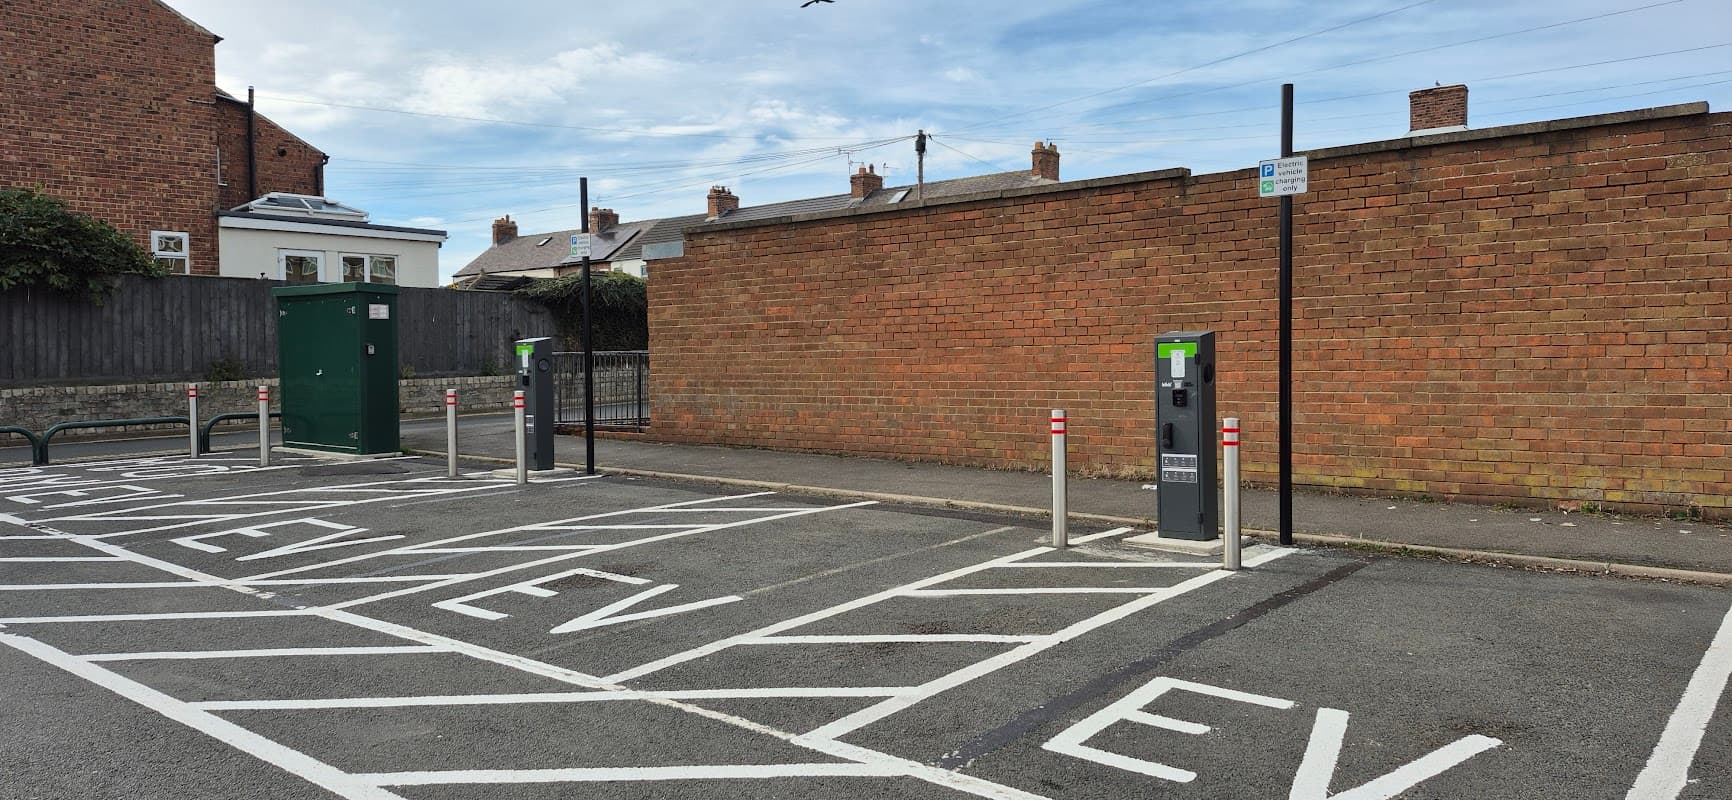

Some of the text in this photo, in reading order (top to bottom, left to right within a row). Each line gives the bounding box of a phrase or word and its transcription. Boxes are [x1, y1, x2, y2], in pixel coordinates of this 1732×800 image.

[1277, 160, 1304, 169] Electric
[1278, 168, 1303, 176] vehicle
[1275, 176, 1306, 185] charging
[1282, 184, 1298, 192] only
[5, 480, 185, 511] EV
[168, 517, 406, 561] EV
[431, 567, 743, 634] EV
[1041, 676, 1503, 800] EV
